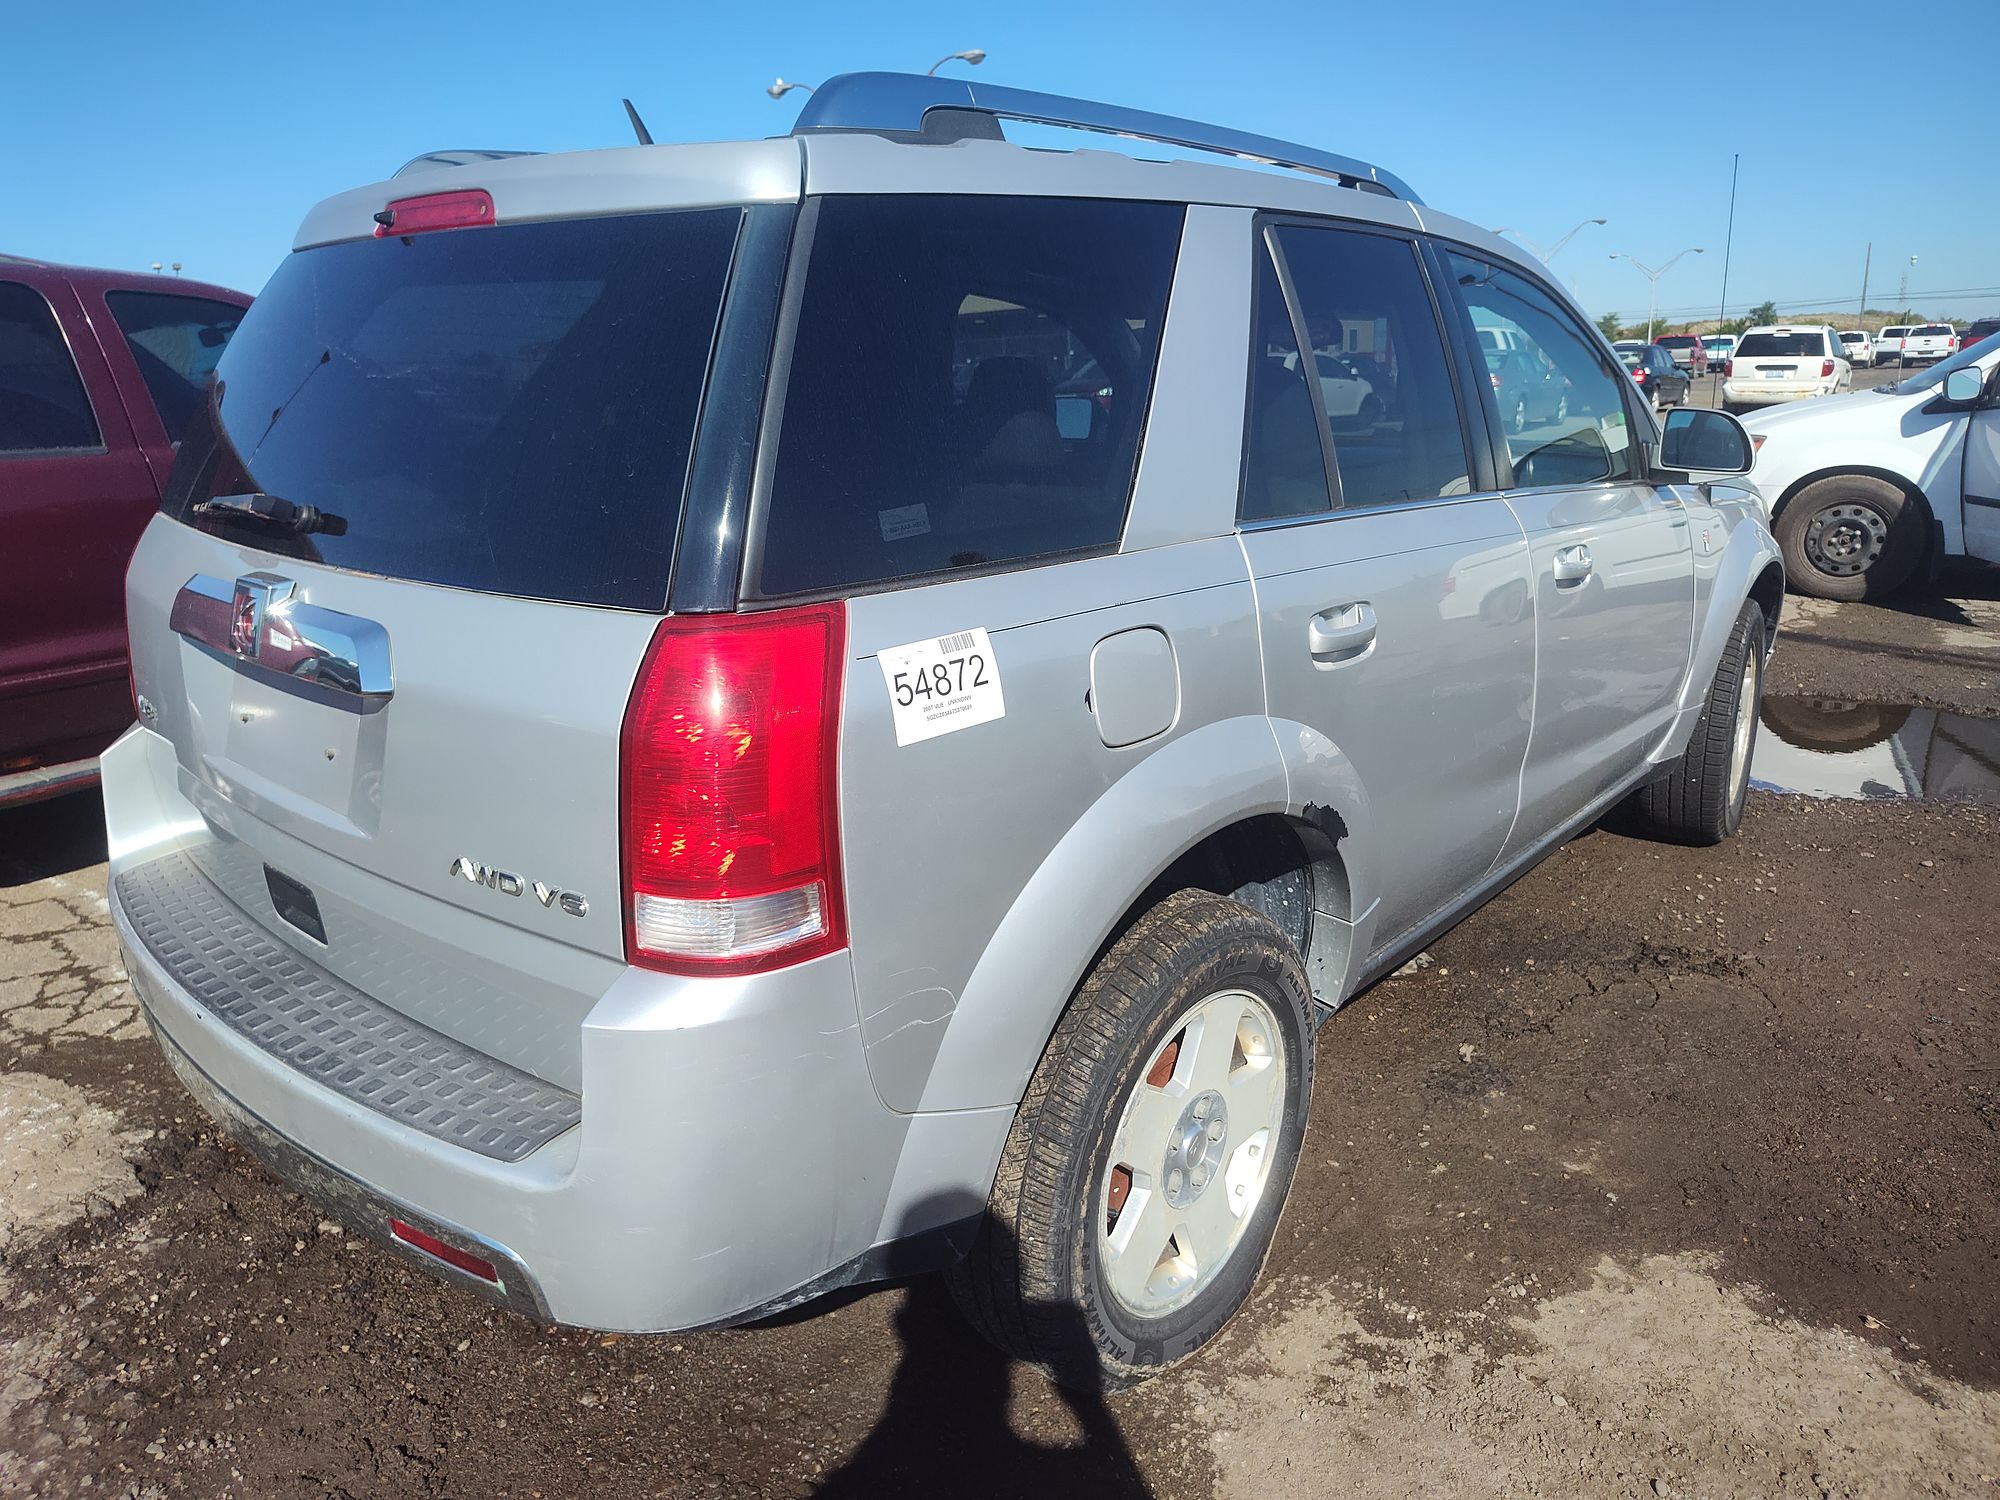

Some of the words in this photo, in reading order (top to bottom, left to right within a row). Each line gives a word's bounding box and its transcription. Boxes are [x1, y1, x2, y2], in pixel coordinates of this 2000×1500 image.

[893, 654, 989, 707] 54872
[922, 704, 934, 713] 2007
[947, 694, 972, 705] UNKNOWN
[449, 856, 525, 898] AWD
[532, 879, 590, 918] V6
[1286, 971, 1314, 1049] ALTIMAX
[1083, 1282, 1127, 1361] ALTIMAX
